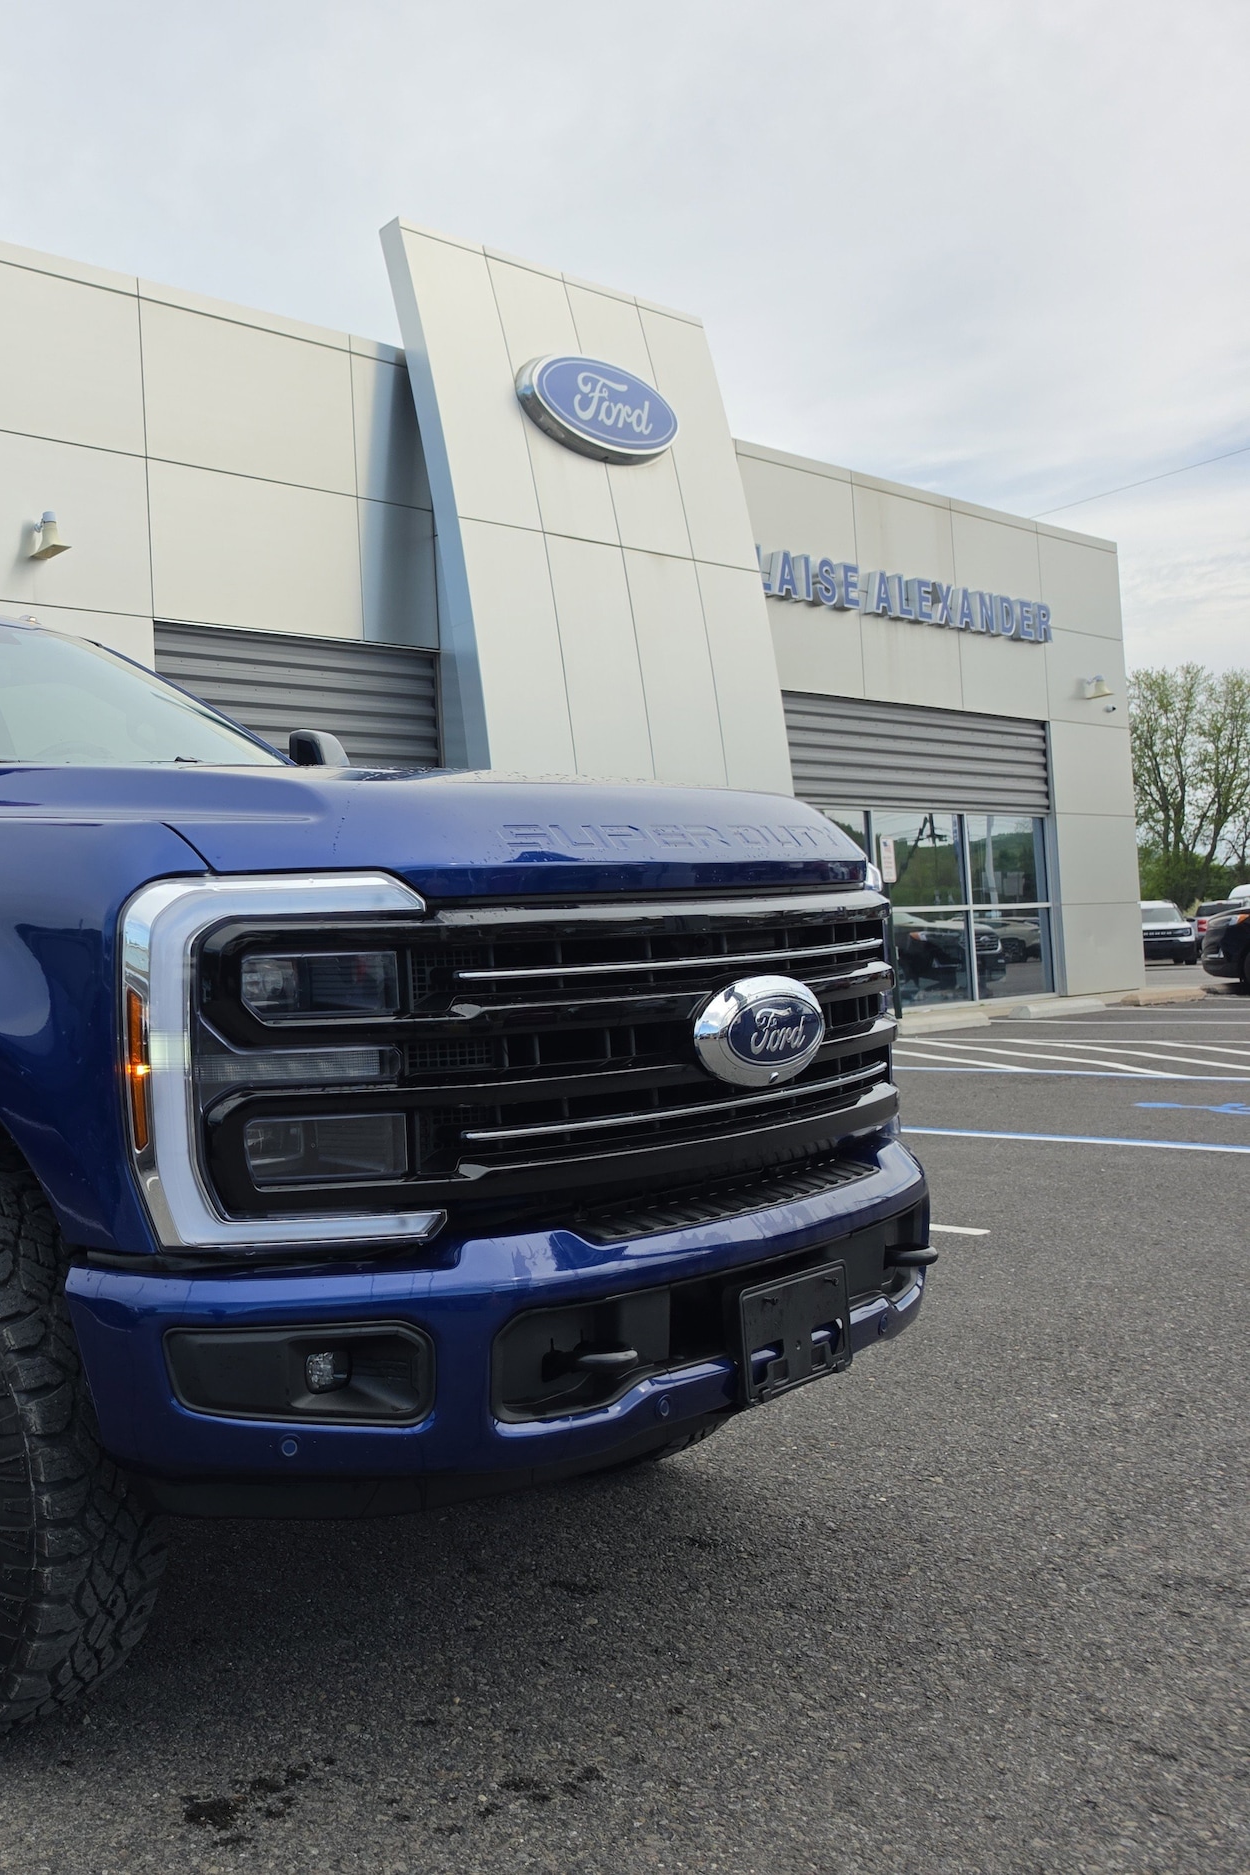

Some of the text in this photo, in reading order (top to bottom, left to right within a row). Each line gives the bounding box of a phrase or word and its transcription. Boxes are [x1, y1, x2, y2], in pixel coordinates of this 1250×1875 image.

[573, 371, 653, 436] Ford
[755, 544, 1053, 642] AISE ALEXANDER
[497, 823, 839, 851] SUPER DUTY
[750, 1006, 806, 1056] Ford
